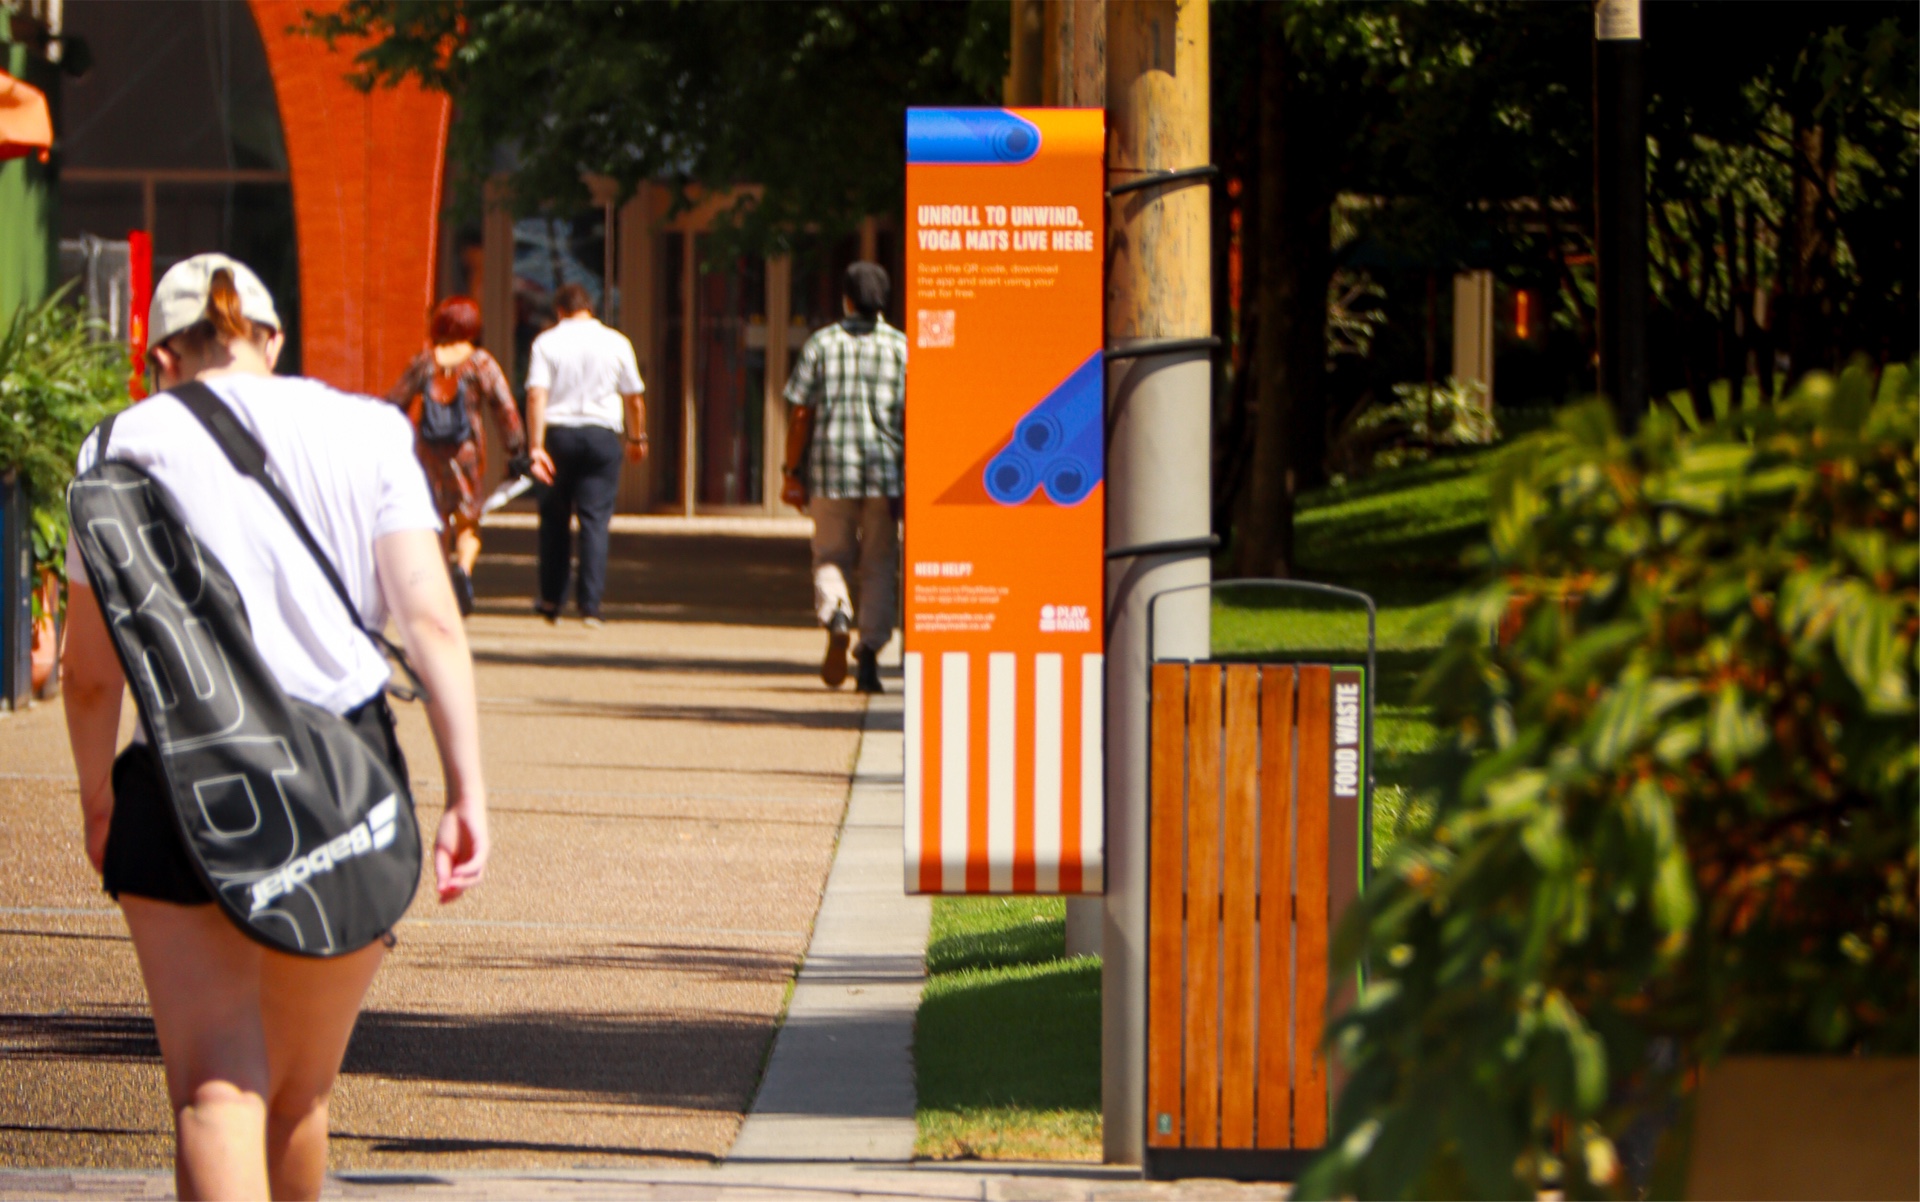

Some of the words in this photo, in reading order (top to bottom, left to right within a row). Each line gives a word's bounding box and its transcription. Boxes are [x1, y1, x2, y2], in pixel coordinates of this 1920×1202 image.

[917, 205, 980, 226] UNROLL
[985, 205, 1007, 226] TO
[1011, 206, 1084, 228] UNWIND,
[917, 230, 962, 250] YOGA
[966, 230, 1009, 251] MATS
[1013, 230, 1048, 251] LIVE
[1052, 230, 1093, 251] HERE
[918, 263, 942, 273] Scan
[945, 264, 961, 273] the
[963, 263, 979, 274] QR
[981, 265, 1008, 275] code,
[1010, 264, 1058, 274] download
[917, 277, 934, 287] the
[936, 278, 955, 288] app
[957, 277, 976, 287] and
[979, 277, 1001, 287] start
[1004, 278, 1031, 288] using
[1033, 278, 1055, 288] your
[918, 288, 936, 298] mat
[939, 288, 953, 298] for
[954, 288, 976, 298] free.
[914, 562, 940, 577] NEED
[941, 562, 973, 577] HELP?
[1056, 605, 1087, 618] PLAY
[1057, 618, 1091, 631] MADE
[1335, 683, 1359, 745] WASTE
[1334, 748, 1358, 796] FOOD
